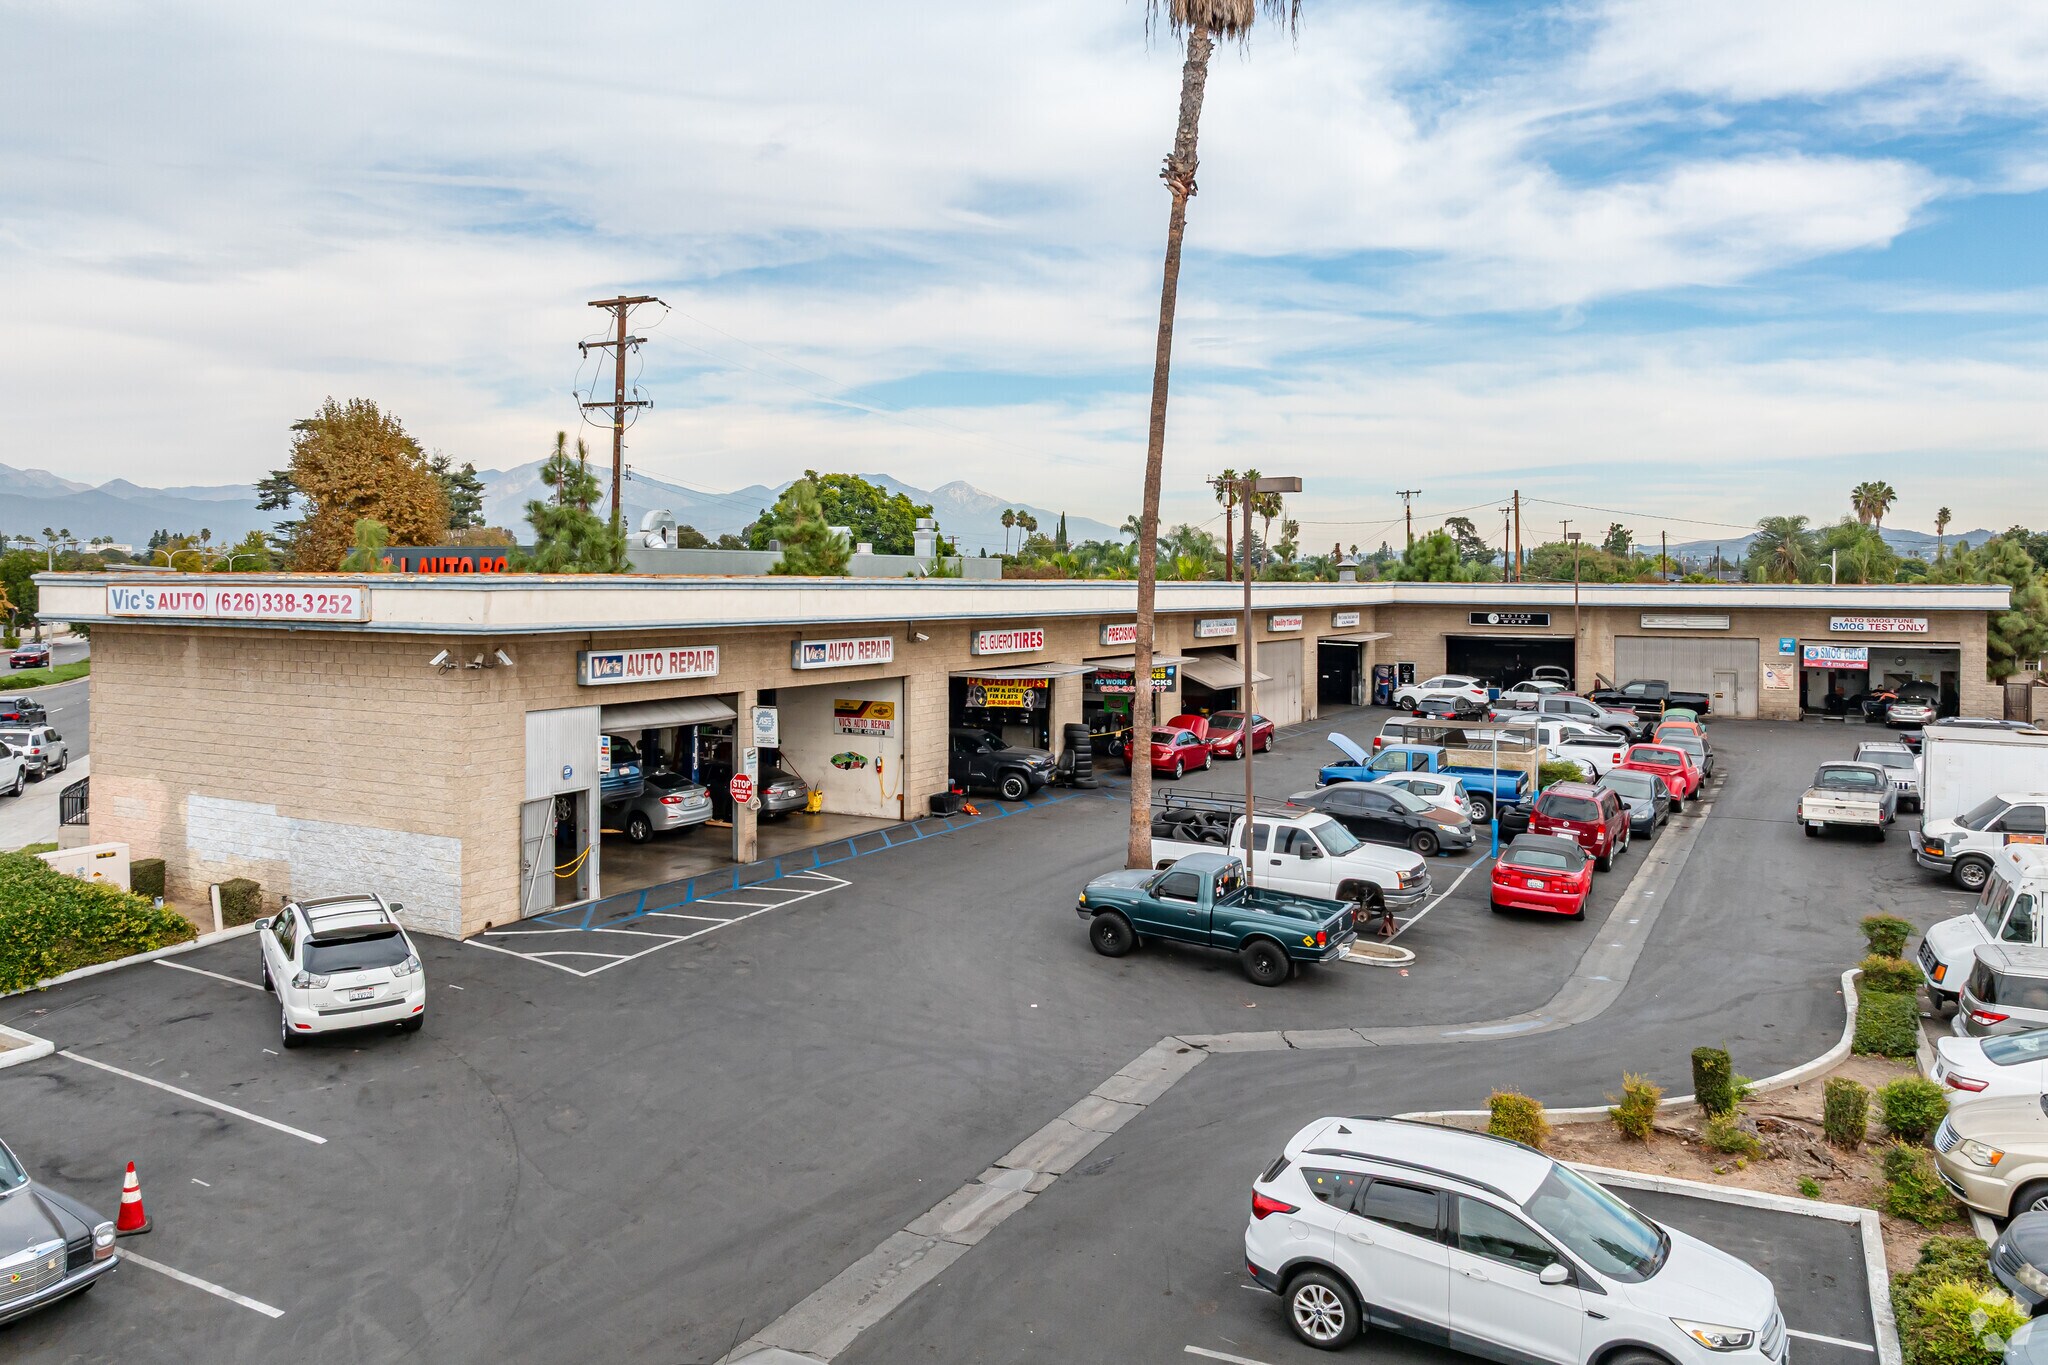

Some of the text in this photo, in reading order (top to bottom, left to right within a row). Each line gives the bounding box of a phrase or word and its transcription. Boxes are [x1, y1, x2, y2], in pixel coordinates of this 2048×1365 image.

[111, 589, 352, 617] Vic's AUTO (626)338-3252
[1108, 626, 1137, 641] PRECISION
[1832, 622, 1926, 631] SMOG TEST ONLY
[980, 631, 1043, 650] EL GUERO TIRES
[828, 641, 854, 662] AUTO
[858, 640, 891, 660] REPAIR
[1820, 647, 1867, 660] SMOG CHECK
[593, 650, 715, 678] Vic's AUTO REPAIR
[758, 716, 772, 725] ASE
[853, 719, 868, 728] AUTO
[870, 720, 891, 730] REPAIR
[732, 780, 751, 789] STOP
